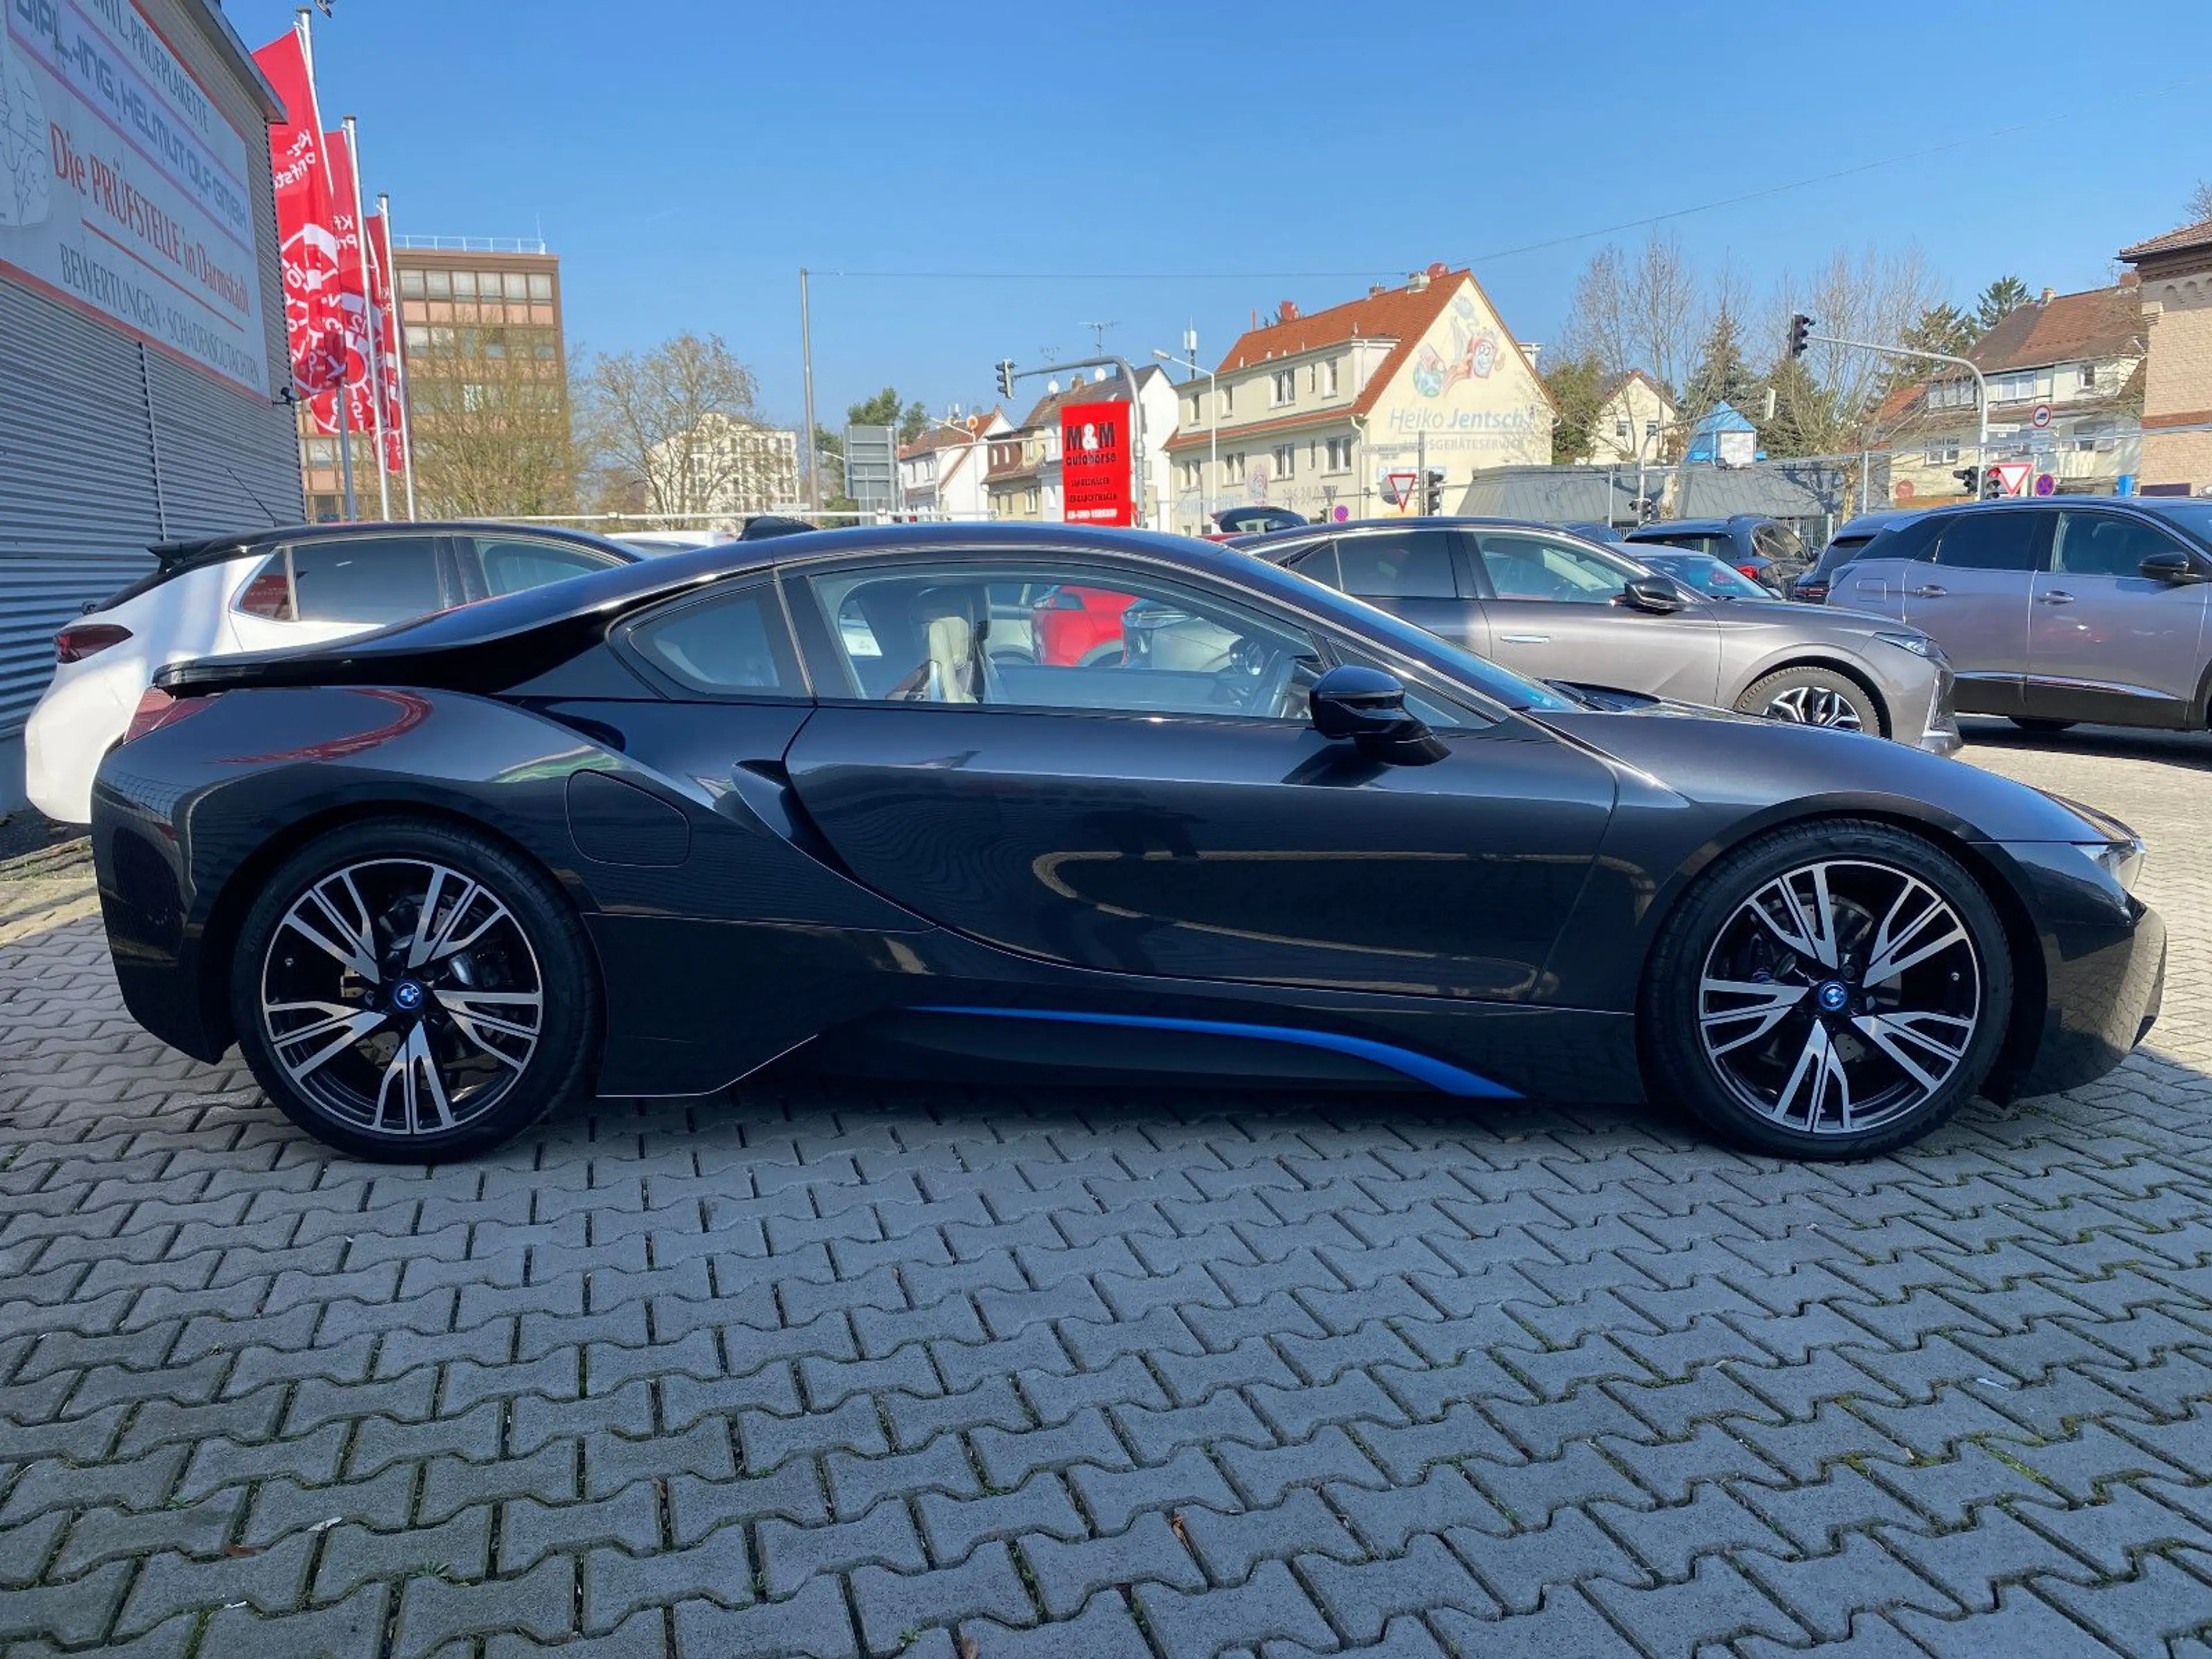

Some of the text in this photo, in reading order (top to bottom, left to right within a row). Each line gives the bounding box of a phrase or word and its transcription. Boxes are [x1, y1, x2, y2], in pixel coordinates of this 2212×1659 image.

[130, 16, 209, 134] PRÜFPLAKETTE
[120, 79, 184, 169] HELMUT
[50, 120, 251, 317] Die PRÜFSTELLE in Darmstadt
[59, 242, 161, 333] BEWERTUNGEN
[1066, 422, 1115, 450] M&M
[1066, 450, 1117, 466] autobörse
[1389, 407, 1524, 430] Heiko Jentsch
